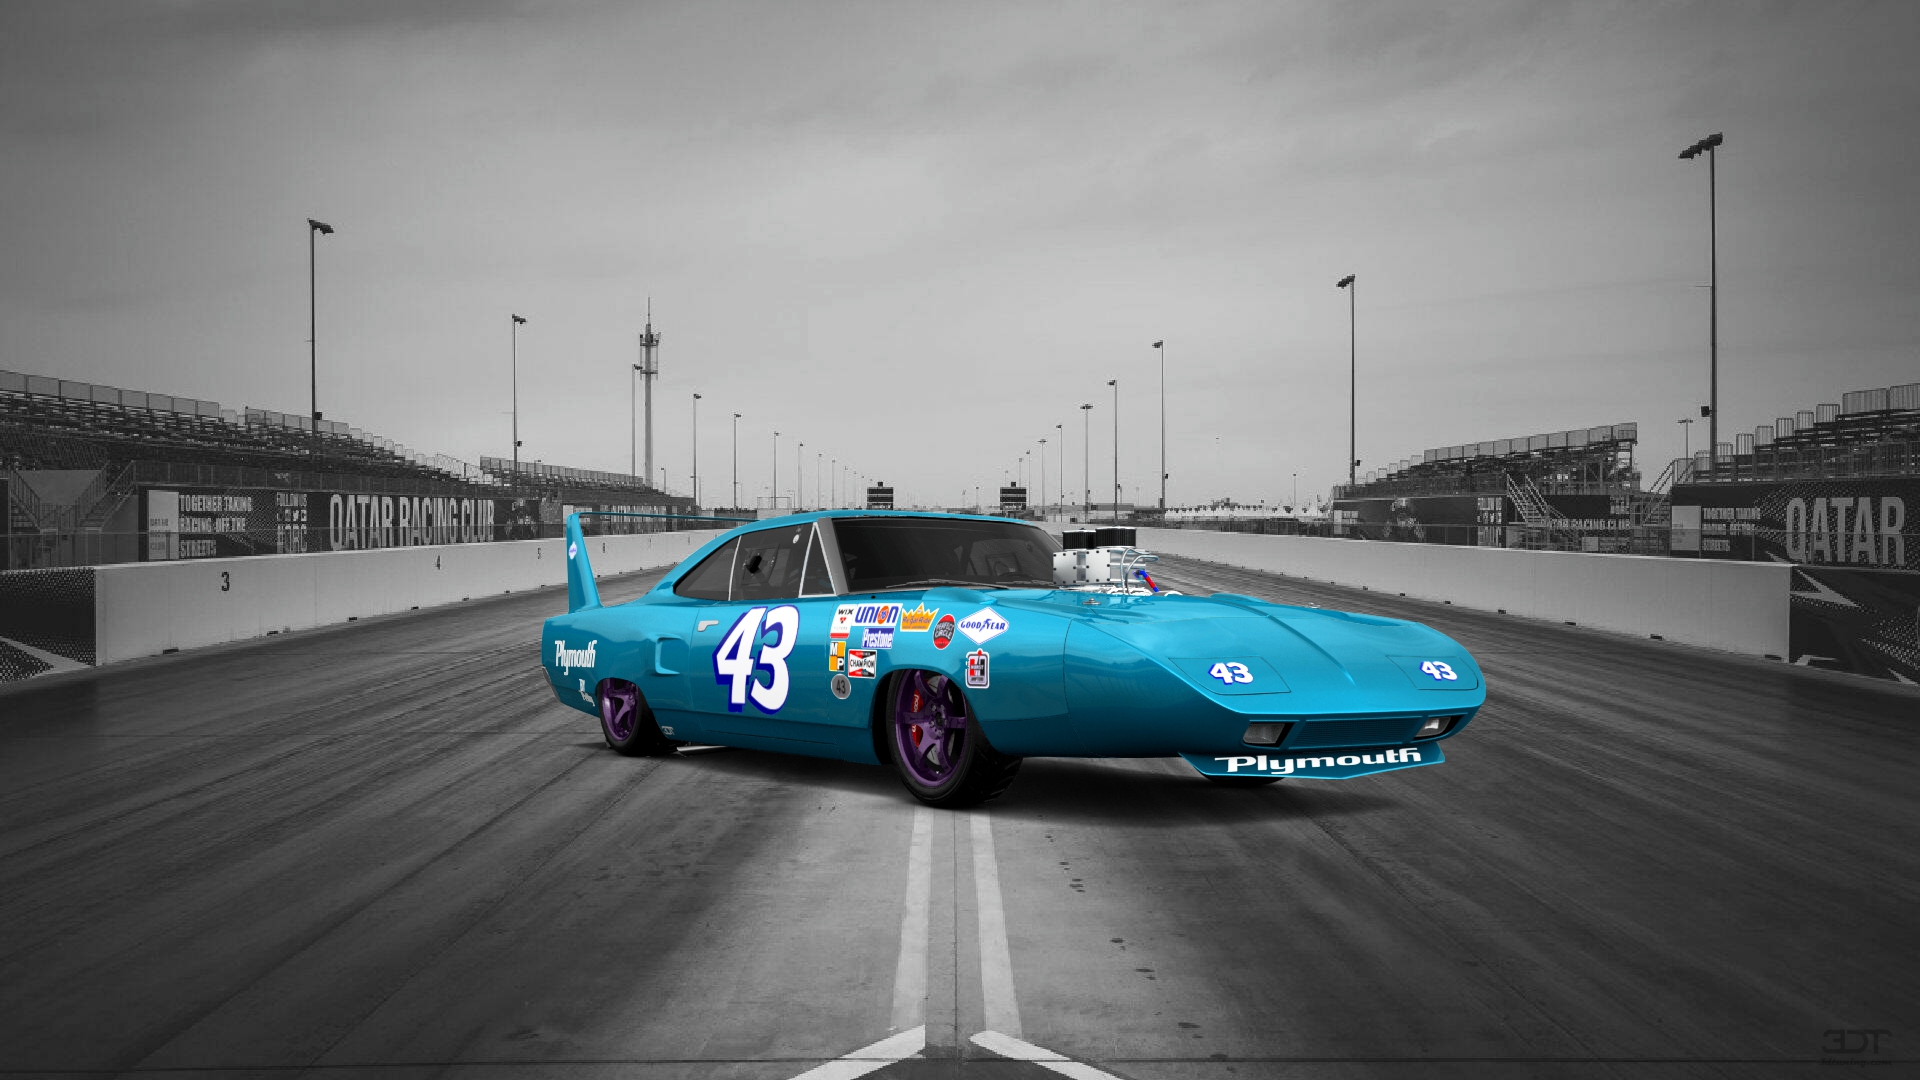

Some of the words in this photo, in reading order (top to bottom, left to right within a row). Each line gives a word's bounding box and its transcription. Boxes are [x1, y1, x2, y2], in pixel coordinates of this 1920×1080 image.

[330, 494, 393, 551] QATAR
[399, 496, 458, 547] RACING
[461, 498, 495, 543] CLUB
[1786, 496, 1905, 565] QATAR
[221, 571, 230, 592] 3
[838, 608, 854, 616] WIX
[935, 630, 952, 640] CIRCLE
[936, 621, 954, 631] PERFECT
[863, 628, 893, 648] Prestone
[554, 640, 597, 676] Plymouth
[712, 604, 800, 715] 43
[849, 658, 875, 668] CHAMPION
[1208, 661, 1254, 685] 43
[1420, 661, 1458, 681] 43
[836, 679, 846, 694] 43
[1214, 748, 1421, 775] Plymouth
